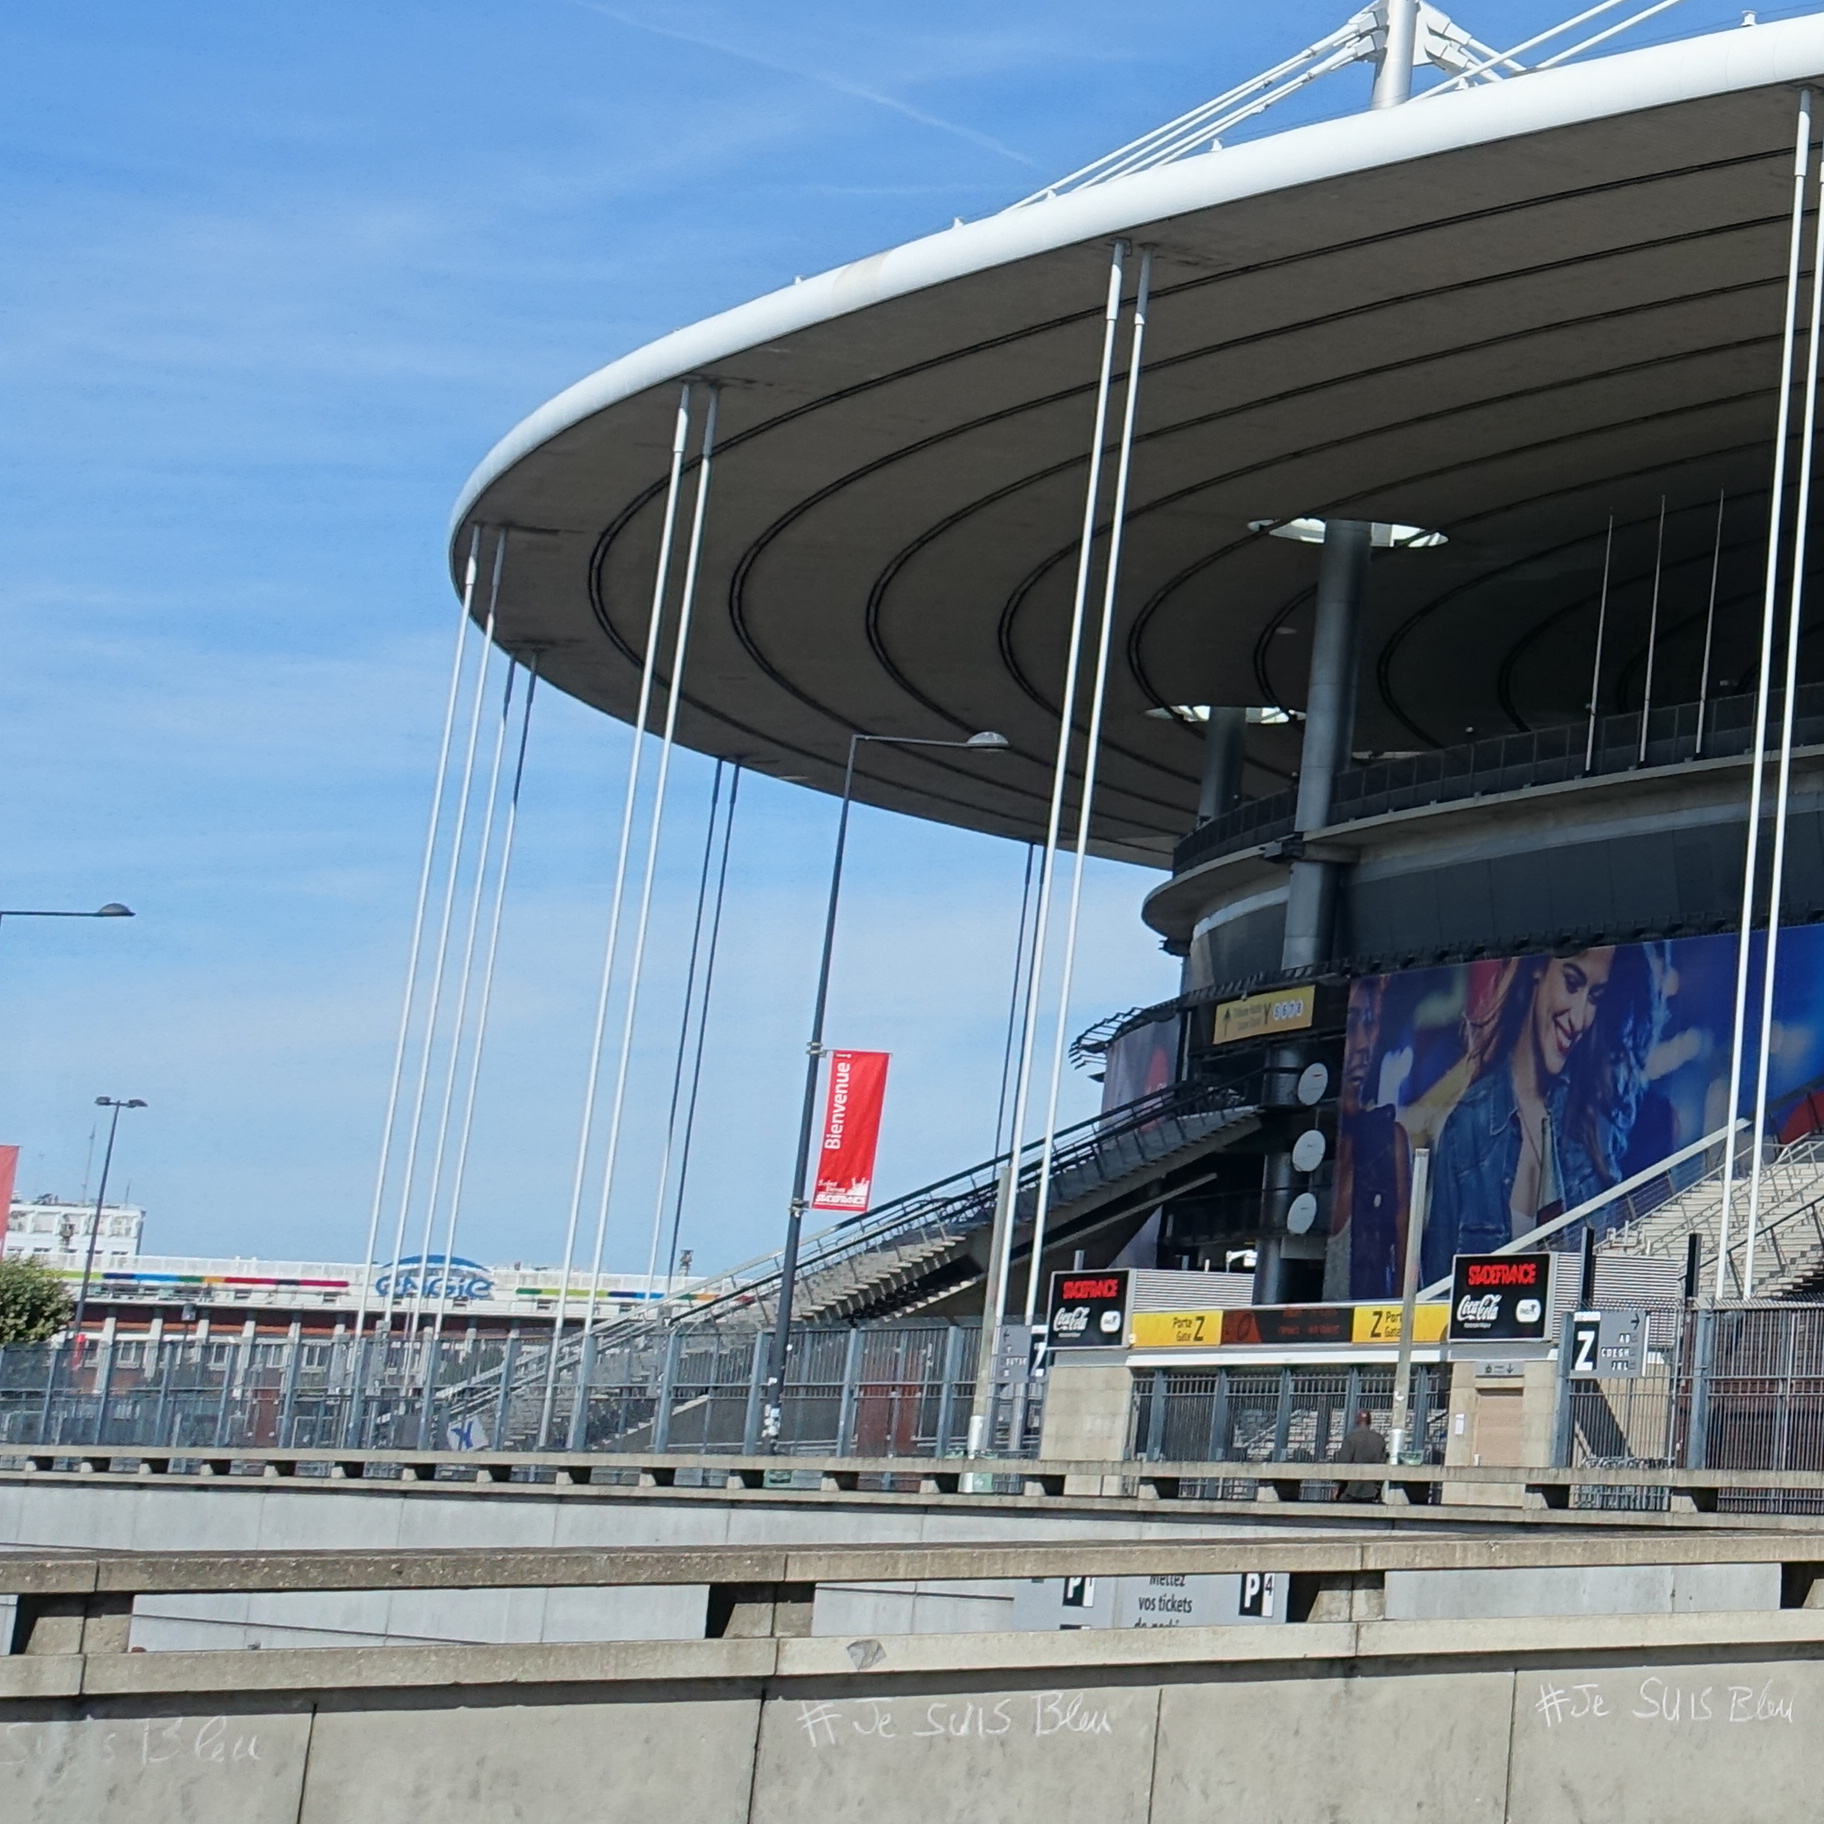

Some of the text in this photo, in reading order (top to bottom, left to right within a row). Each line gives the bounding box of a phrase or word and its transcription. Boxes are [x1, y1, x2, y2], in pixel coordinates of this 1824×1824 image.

[824, 1062, 850, 1149] Bienvenue
[1053, 1307, 1090, 1332] Coca-Cola
[1457, 1294, 1502, 1321] Coca-Cola
[1173, 1316, 1205, 1341] Porte Z
[1575, 1331, 1595, 1371] Z
[1139, 1593, 1193, 1613] vos tickets
[1244, 1573, 1260, 1608] P
[1265, 1575, 1273, 1596] 4
